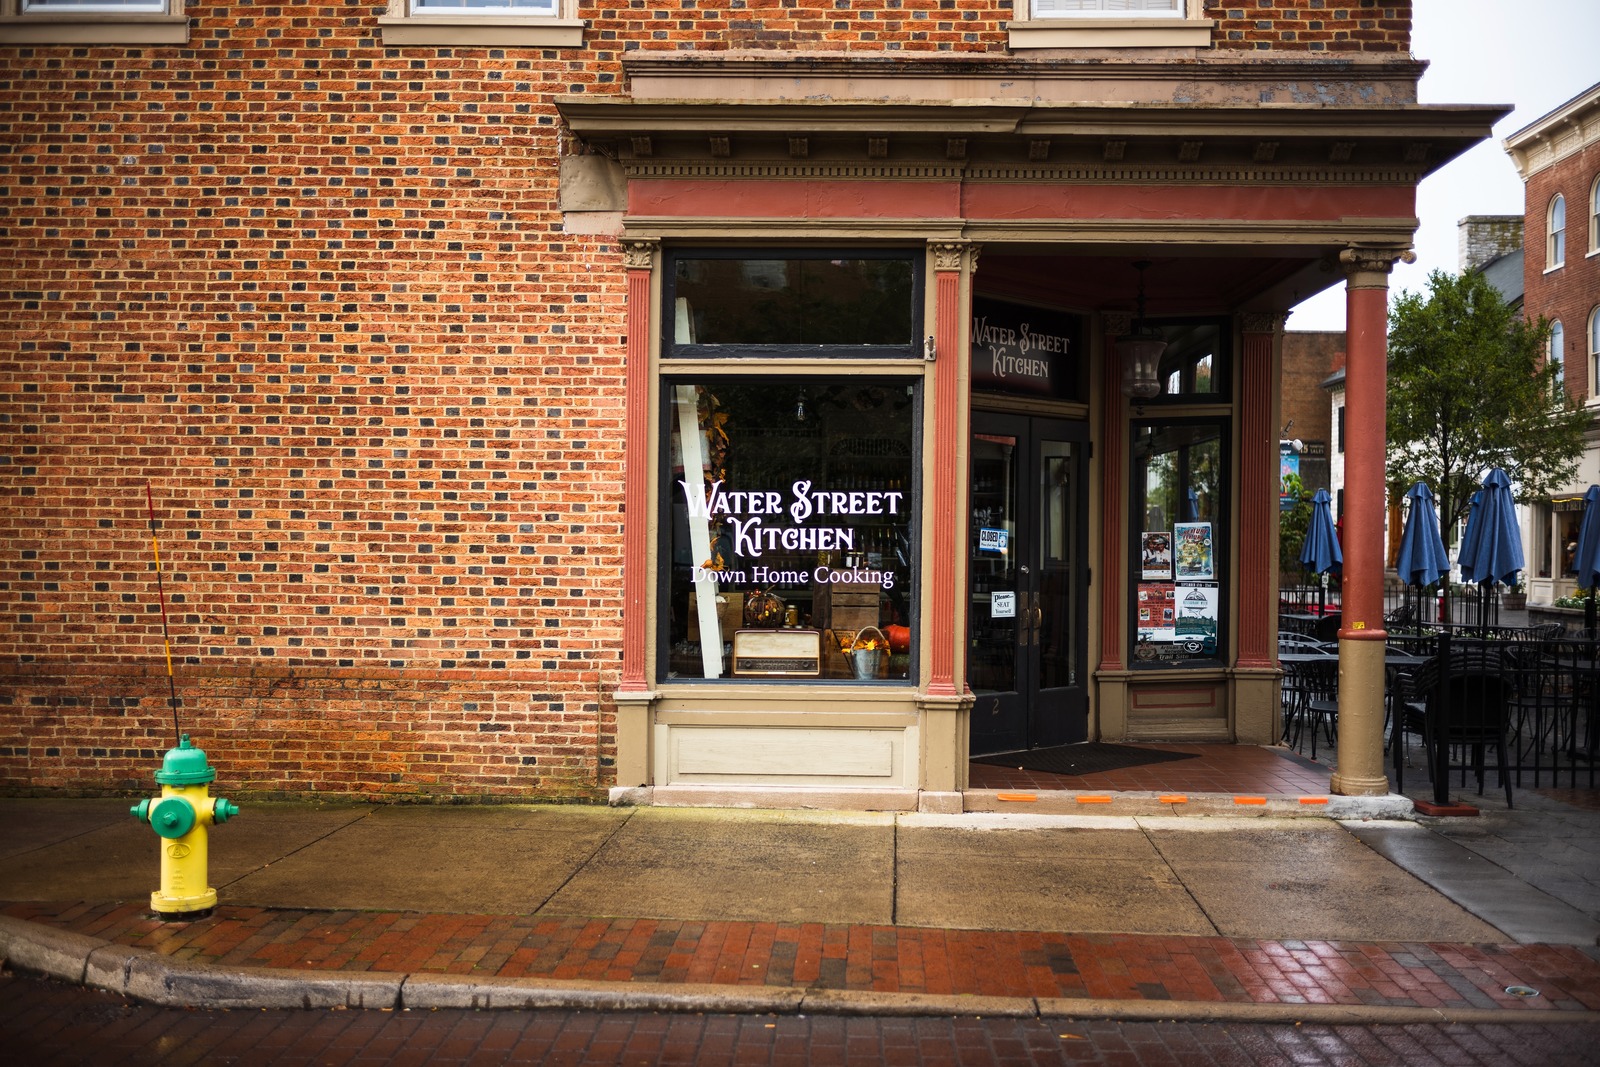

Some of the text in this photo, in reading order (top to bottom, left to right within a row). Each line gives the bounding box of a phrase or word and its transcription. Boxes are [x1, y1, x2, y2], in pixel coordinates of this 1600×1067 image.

[972, 316, 1070, 354] WATER STREET
[989, 345, 1049, 378] KITCHEN
[678, 479, 903, 523] WATER STREET
[727, 516, 854, 557] KITCHEN
[981, 530, 998, 542] CLOSED
[690, 566, 894, 589] Down Home Cooking
[992, 698, 1000, 716] 2
